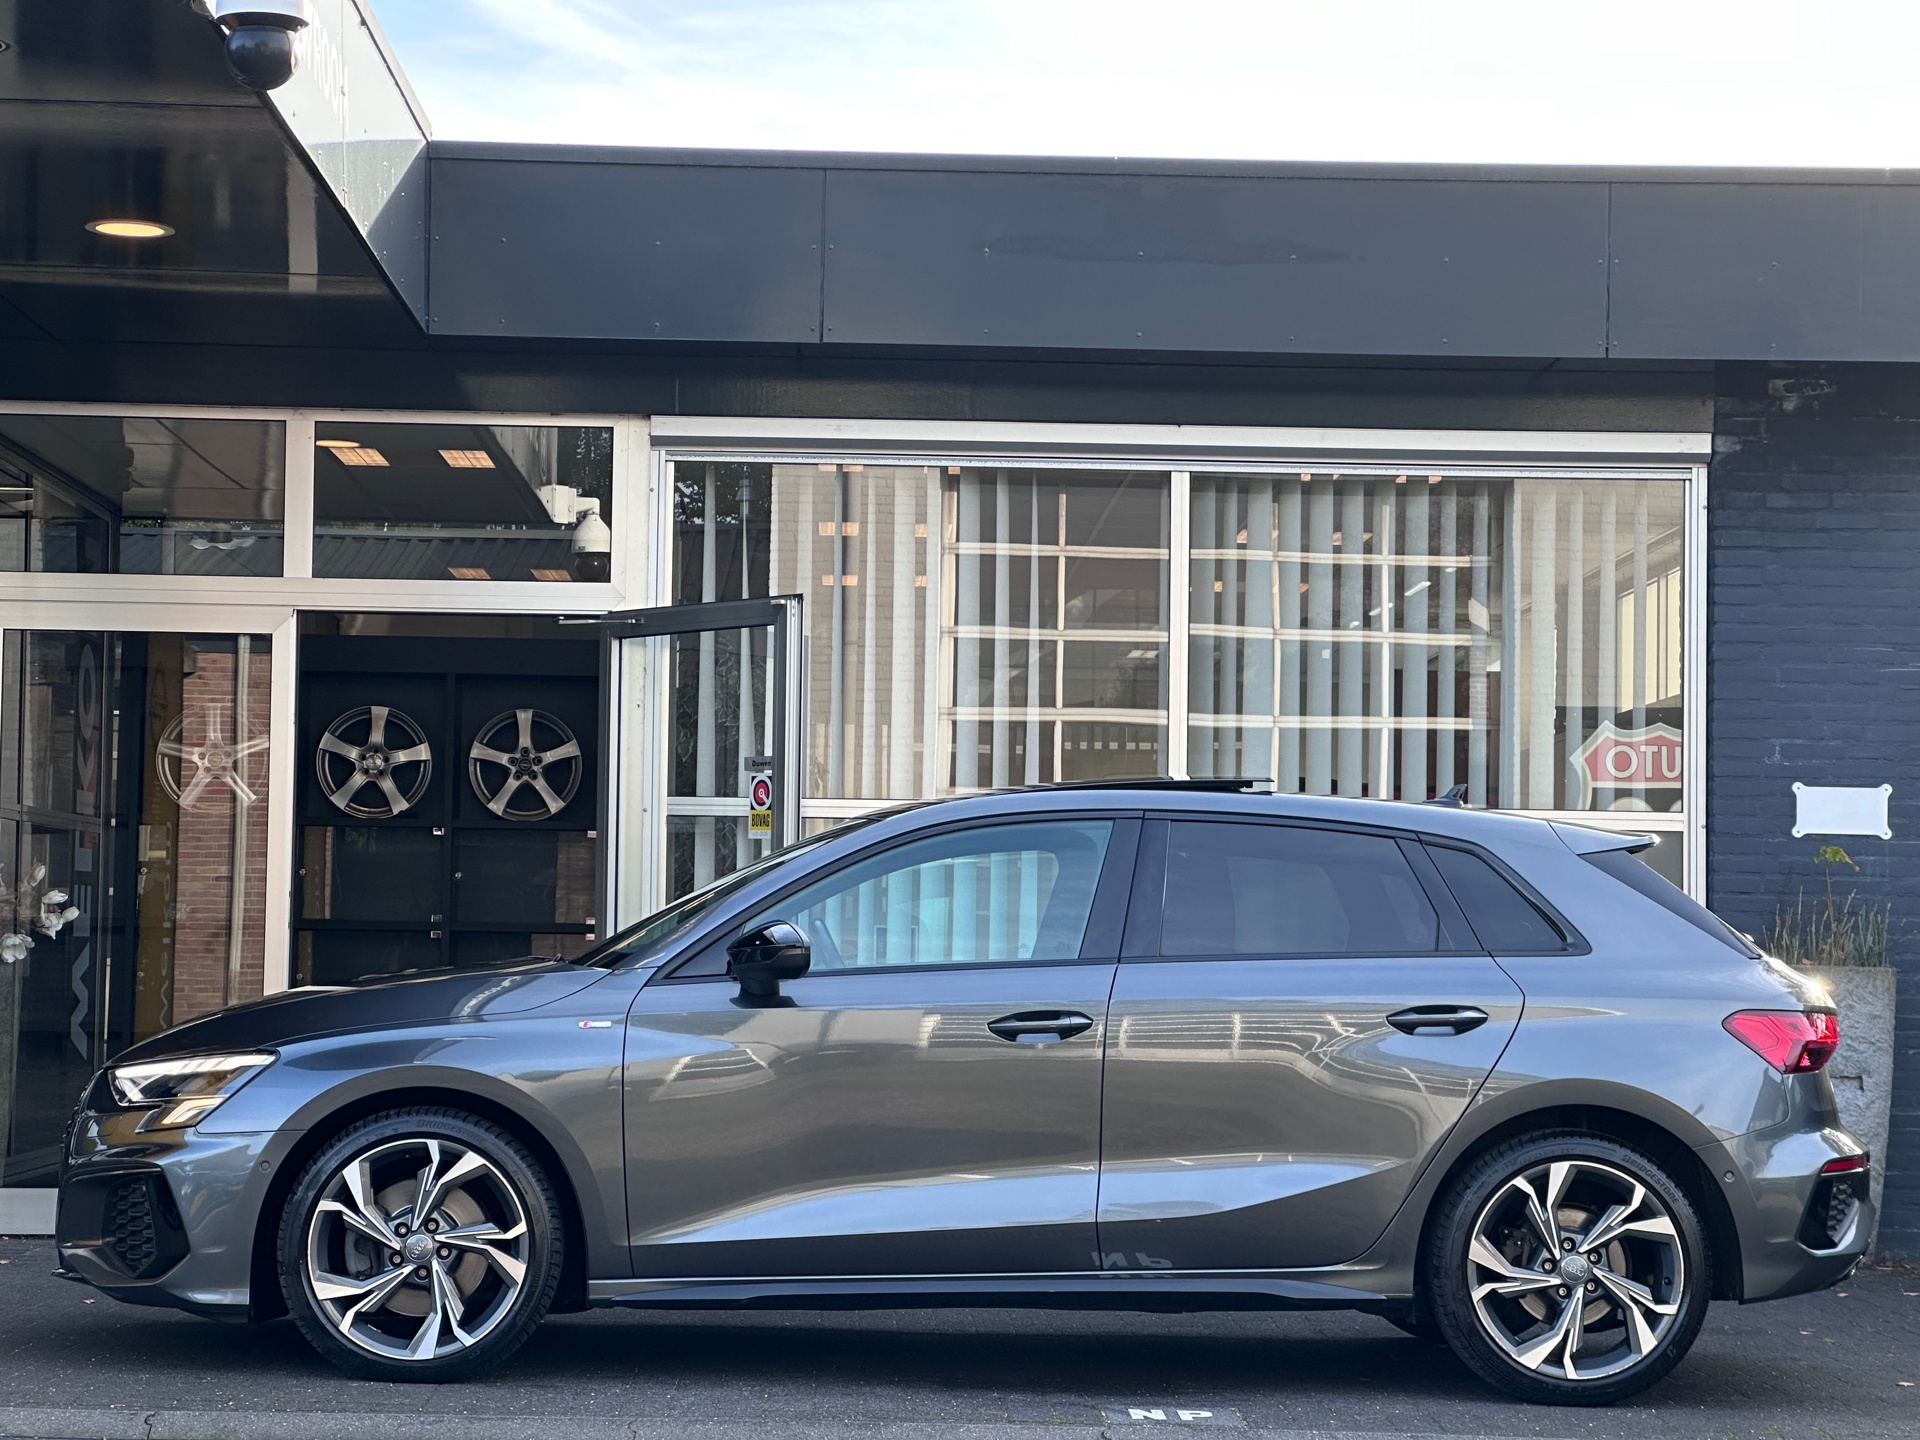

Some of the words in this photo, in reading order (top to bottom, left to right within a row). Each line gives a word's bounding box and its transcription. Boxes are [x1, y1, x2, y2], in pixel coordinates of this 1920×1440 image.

[751, 813, 770, 827] BOVAG
[417, 1119, 486, 1145] BRIDGESTONE
[1621, 1154, 1680, 1205] BRIDGESTONE
